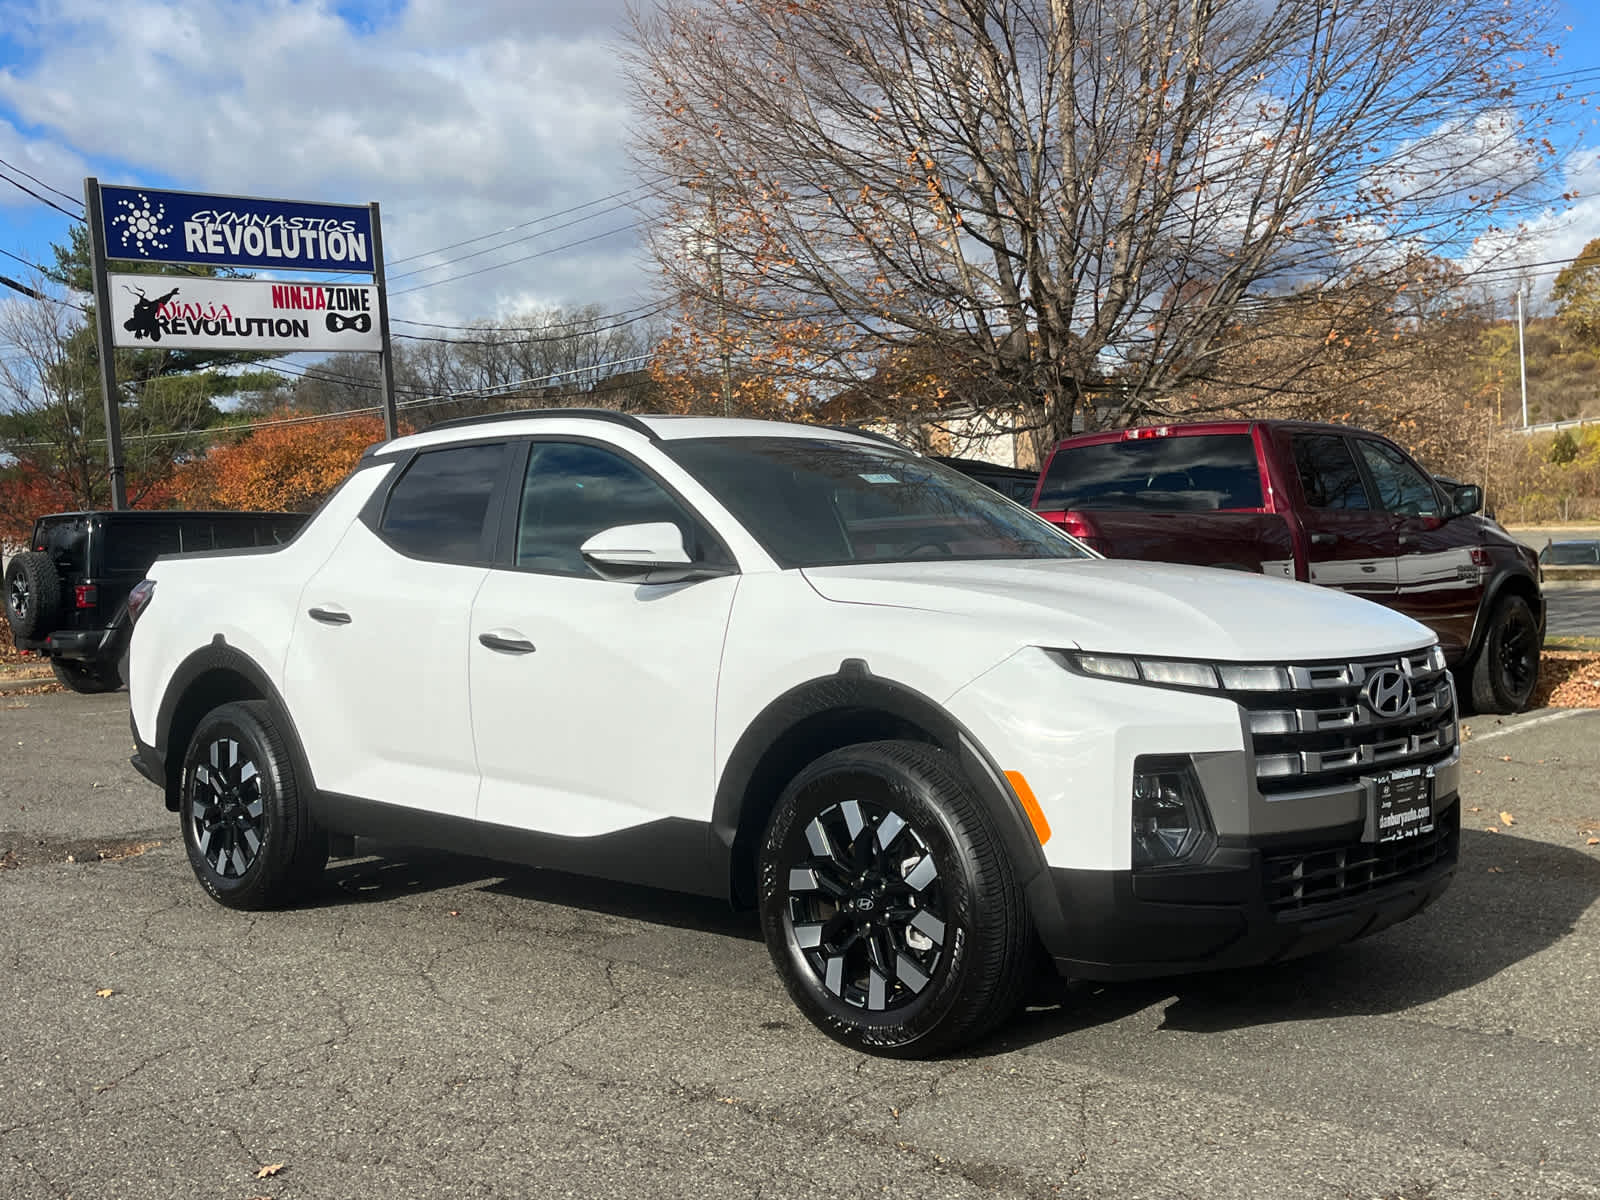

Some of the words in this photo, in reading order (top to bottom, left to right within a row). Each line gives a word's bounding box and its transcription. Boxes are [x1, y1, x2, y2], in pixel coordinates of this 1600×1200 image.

[191, 210, 356, 234] GYMNASTICS
[184, 221, 367, 262] REVOLUTION
[272, 285, 370, 311] NINJAZONE
[158, 315, 309, 338] REVOLUTION
